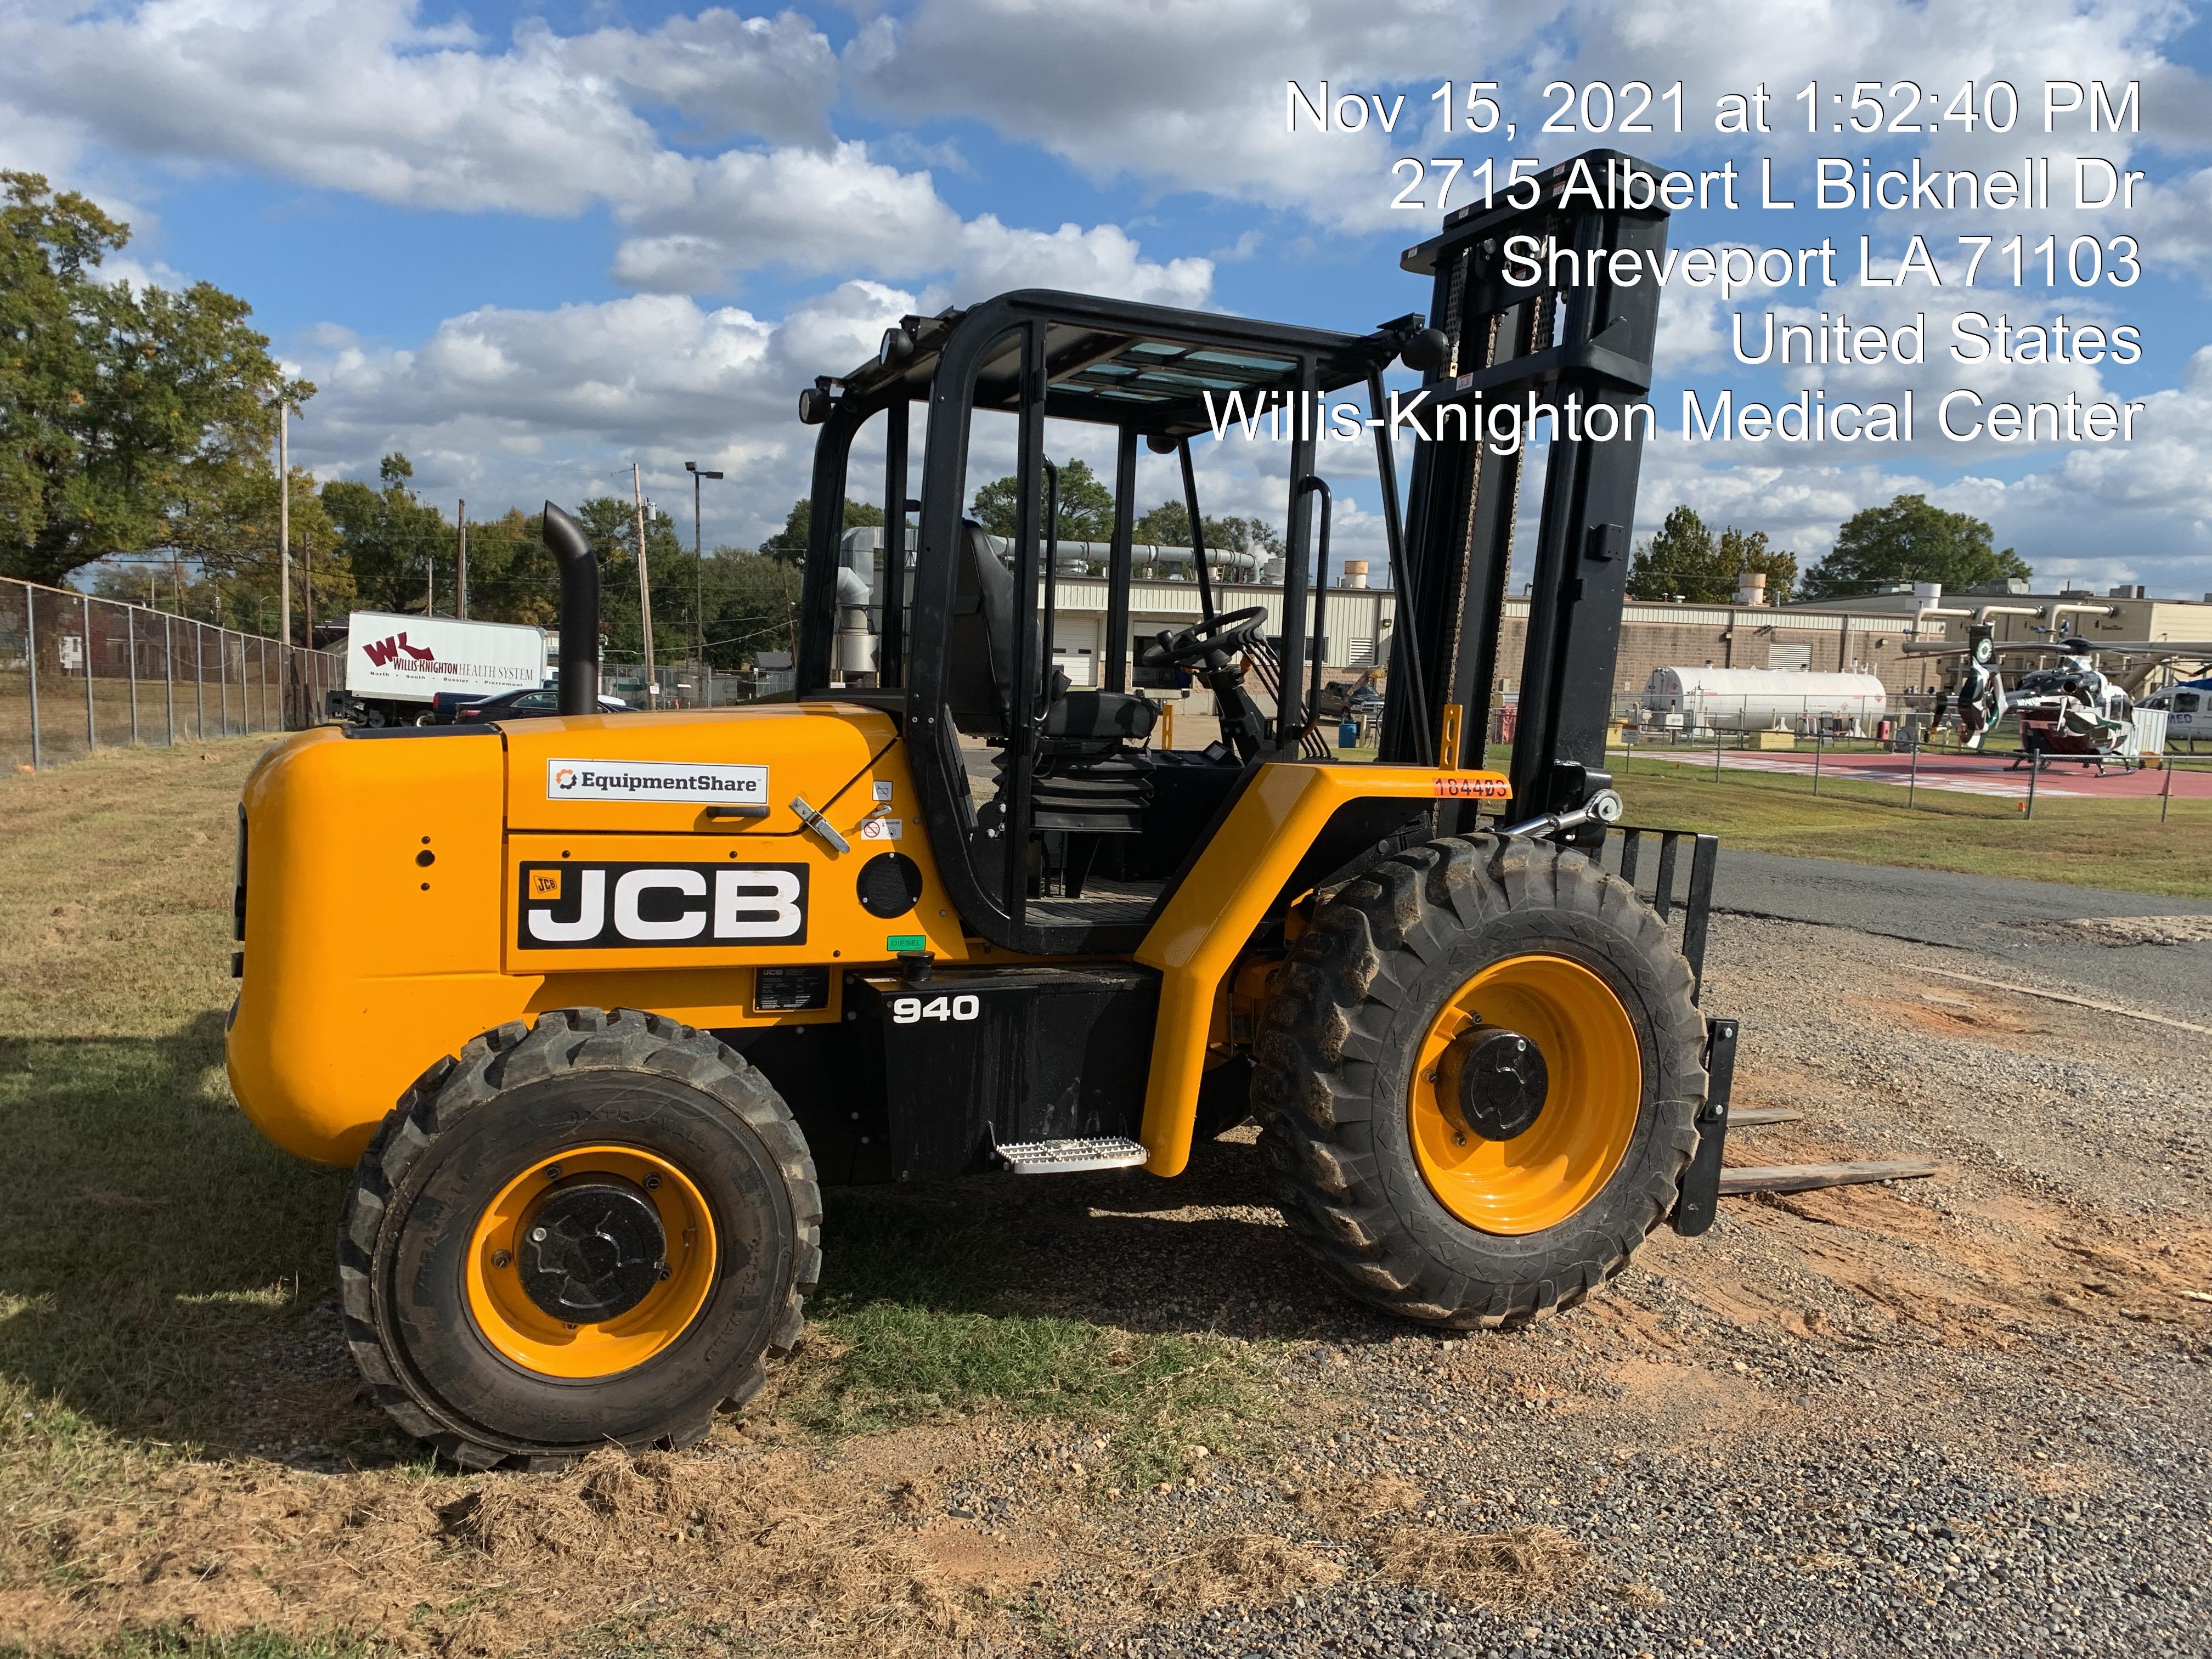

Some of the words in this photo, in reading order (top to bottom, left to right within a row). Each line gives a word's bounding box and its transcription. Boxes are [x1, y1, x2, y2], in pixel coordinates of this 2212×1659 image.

[459, 662, 496, 678] HEALTH
[497, 665, 533, 681] SYSTEM
[581, 771, 757, 792] EquipmentShare
[537, 878, 556, 892] JCB
[528, 869, 802, 941] JCB
[893, 995, 980, 1024] 940
